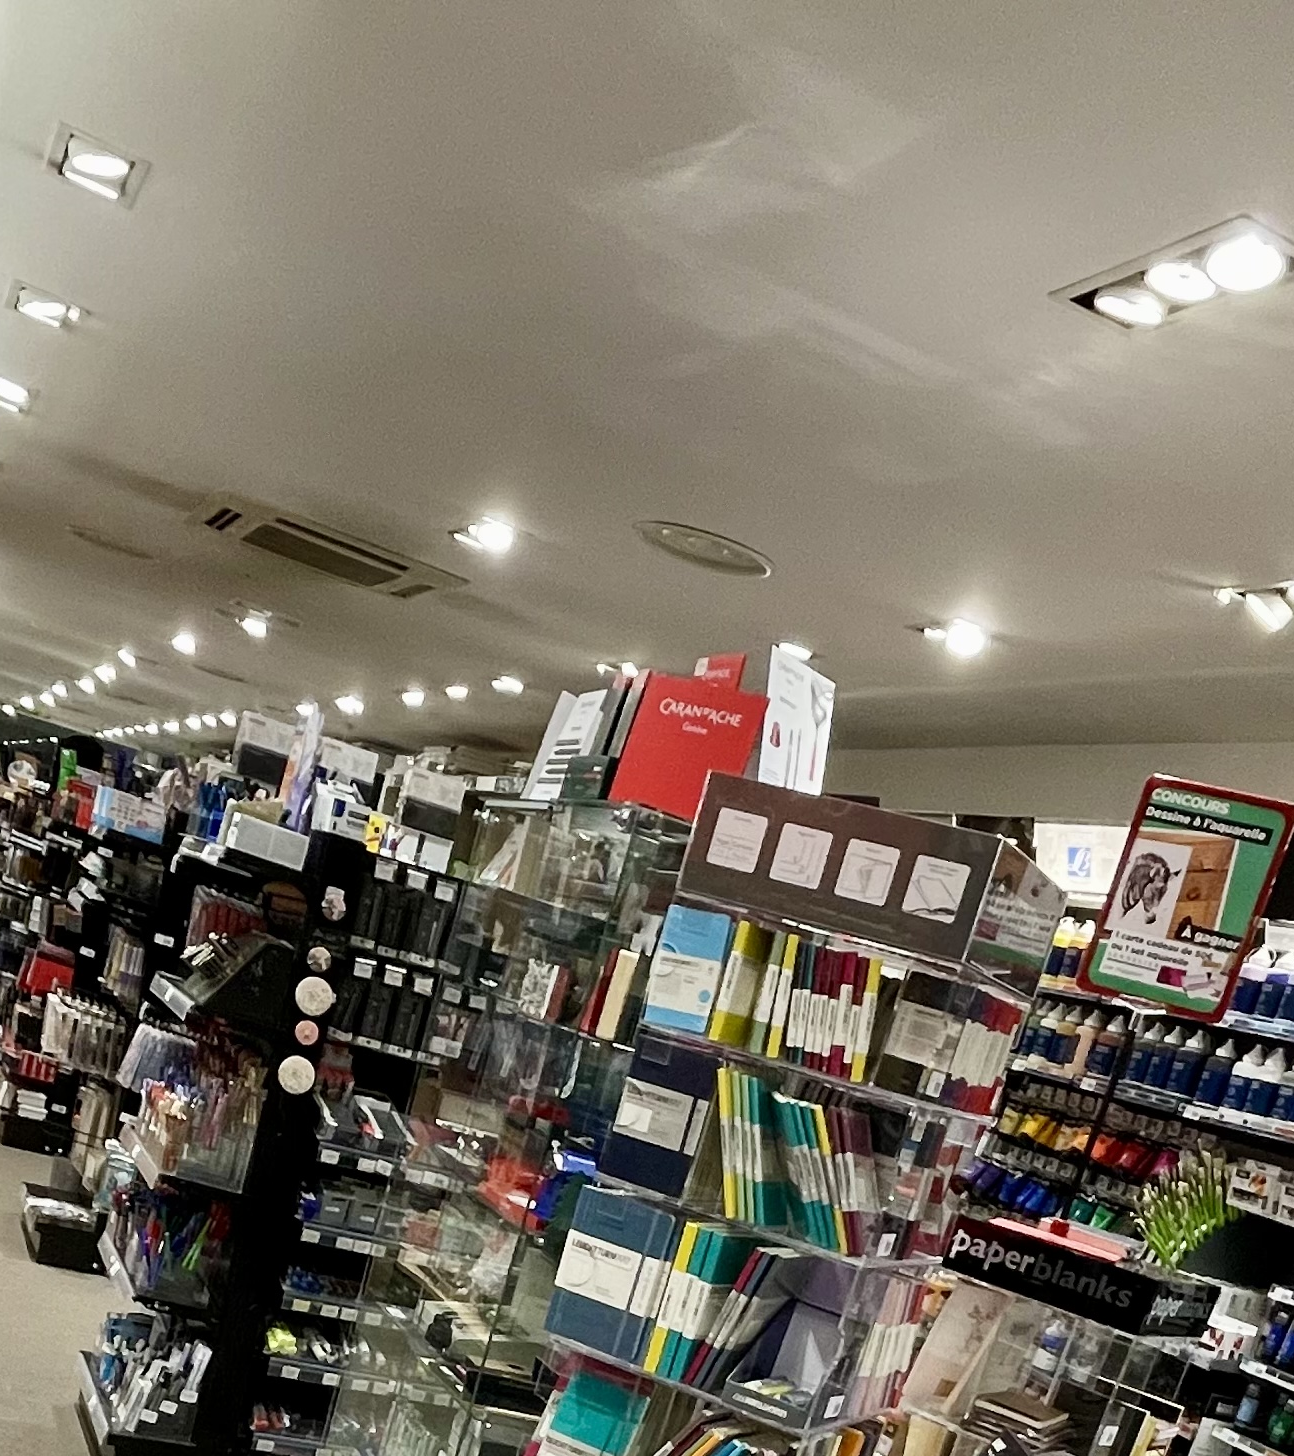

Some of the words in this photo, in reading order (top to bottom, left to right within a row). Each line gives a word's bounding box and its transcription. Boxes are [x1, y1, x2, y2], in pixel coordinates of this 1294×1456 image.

[1152, 788, 1231, 815] CONCOURS
[1145, 806, 1191, 826] Dessine
[948, 1228, 1134, 1309] paperblanks
